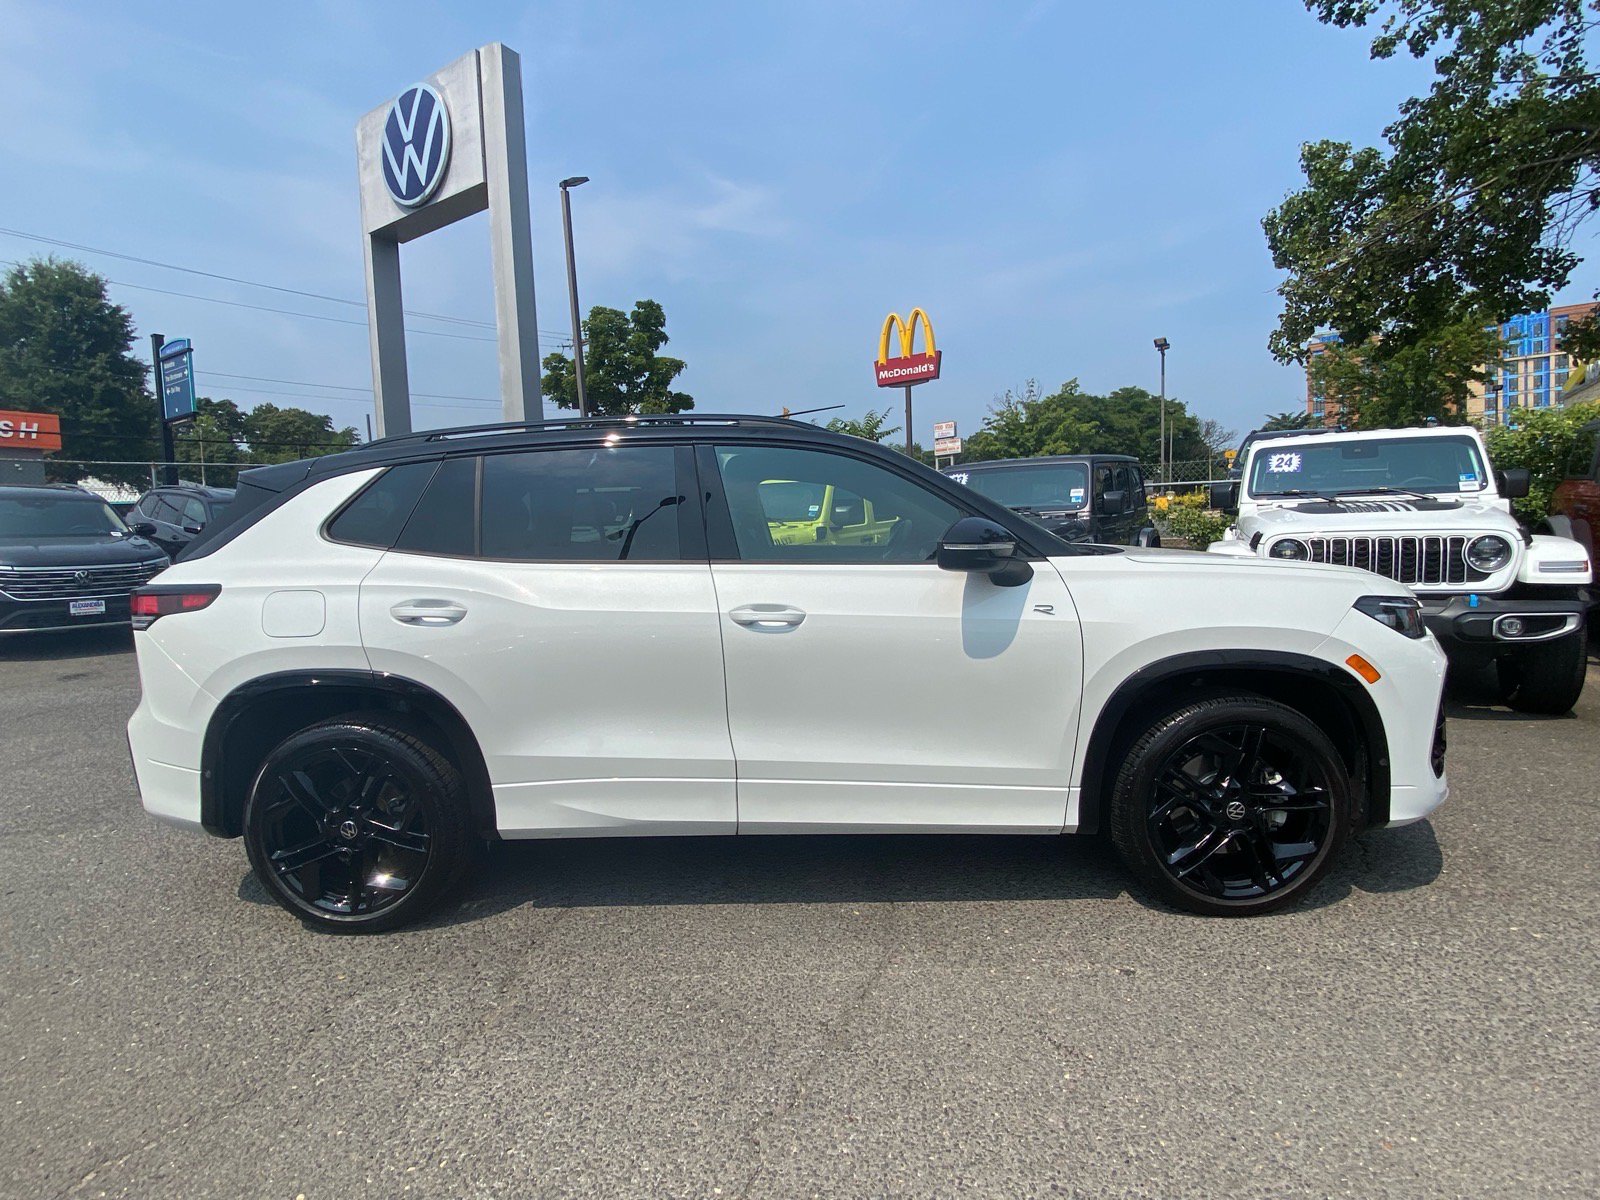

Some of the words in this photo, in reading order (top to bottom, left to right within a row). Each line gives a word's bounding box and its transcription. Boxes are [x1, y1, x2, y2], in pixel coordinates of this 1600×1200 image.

[879, 363, 935, 380] McDonald's
[0, 420, 39, 439] SH
[1275, 457, 1293, 468] 24
